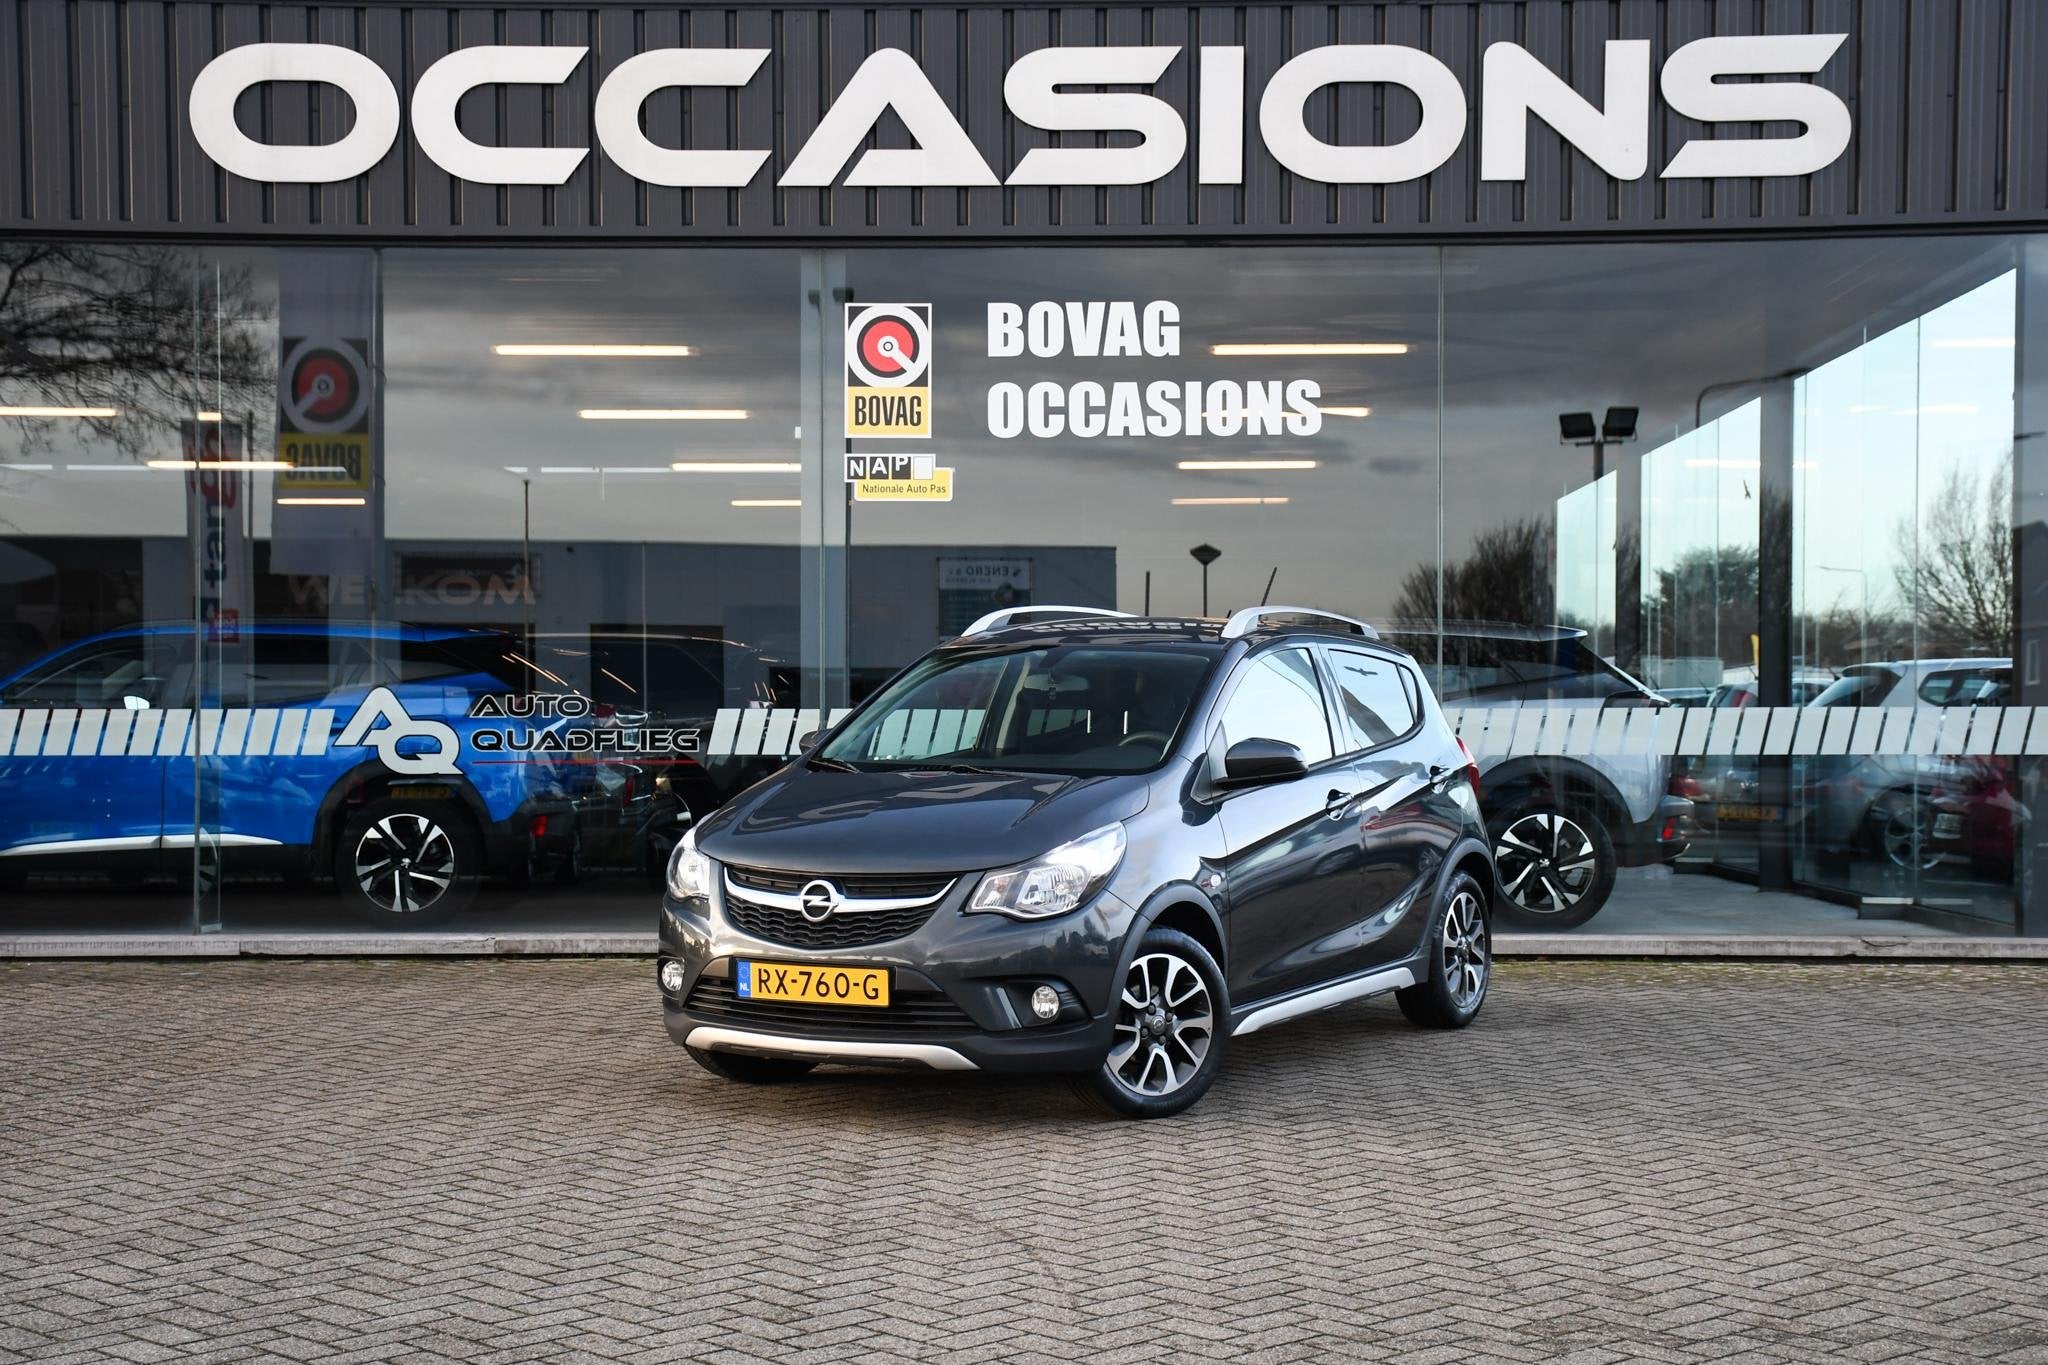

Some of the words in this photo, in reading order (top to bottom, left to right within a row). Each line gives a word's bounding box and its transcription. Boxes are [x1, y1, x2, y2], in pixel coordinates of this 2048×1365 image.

[189, 32, 1852, 187] OCCASIONS
[987, 300, 1180, 358] BOVAG
[854, 395, 922, 427] BOVAG
[987, 380, 1322, 438] OCCASIONS
[849, 456, 909, 477] NAP
[862, 484, 904, 494] Nationale
[906, 484, 928, 494] Auto
[930, 484, 947, 494] Pas
[469, 694, 591, 719] AUTO
[470, 728, 700, 753] QUADFLIEG
[739, 982, 749, 992] NL
[758, 967, 880, 1000] RX-760-G
